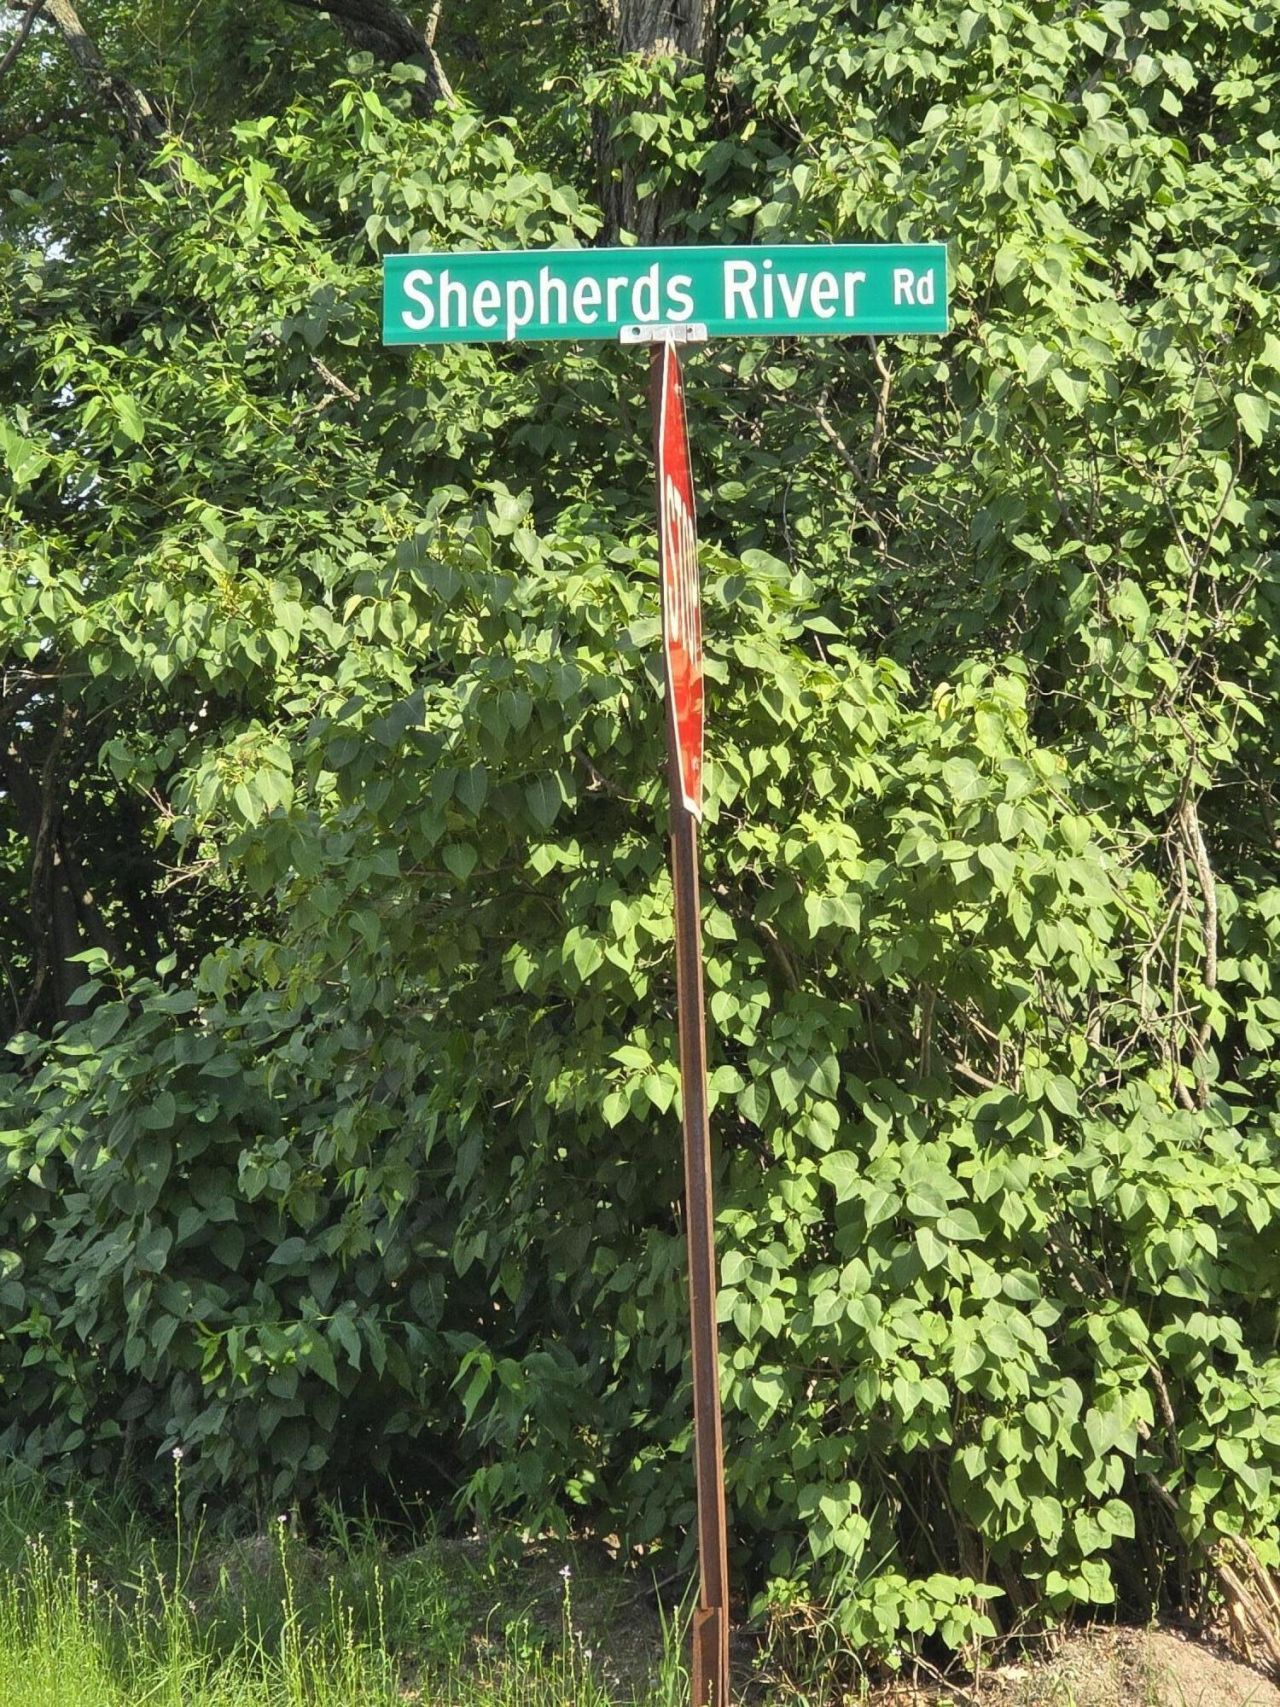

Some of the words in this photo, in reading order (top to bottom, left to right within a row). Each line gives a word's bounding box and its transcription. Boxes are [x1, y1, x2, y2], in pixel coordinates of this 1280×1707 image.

[401, 262, 693, 341] Shepherds
[723, 259, 866, 320] River
[893, 267, 935, 305] Rd
